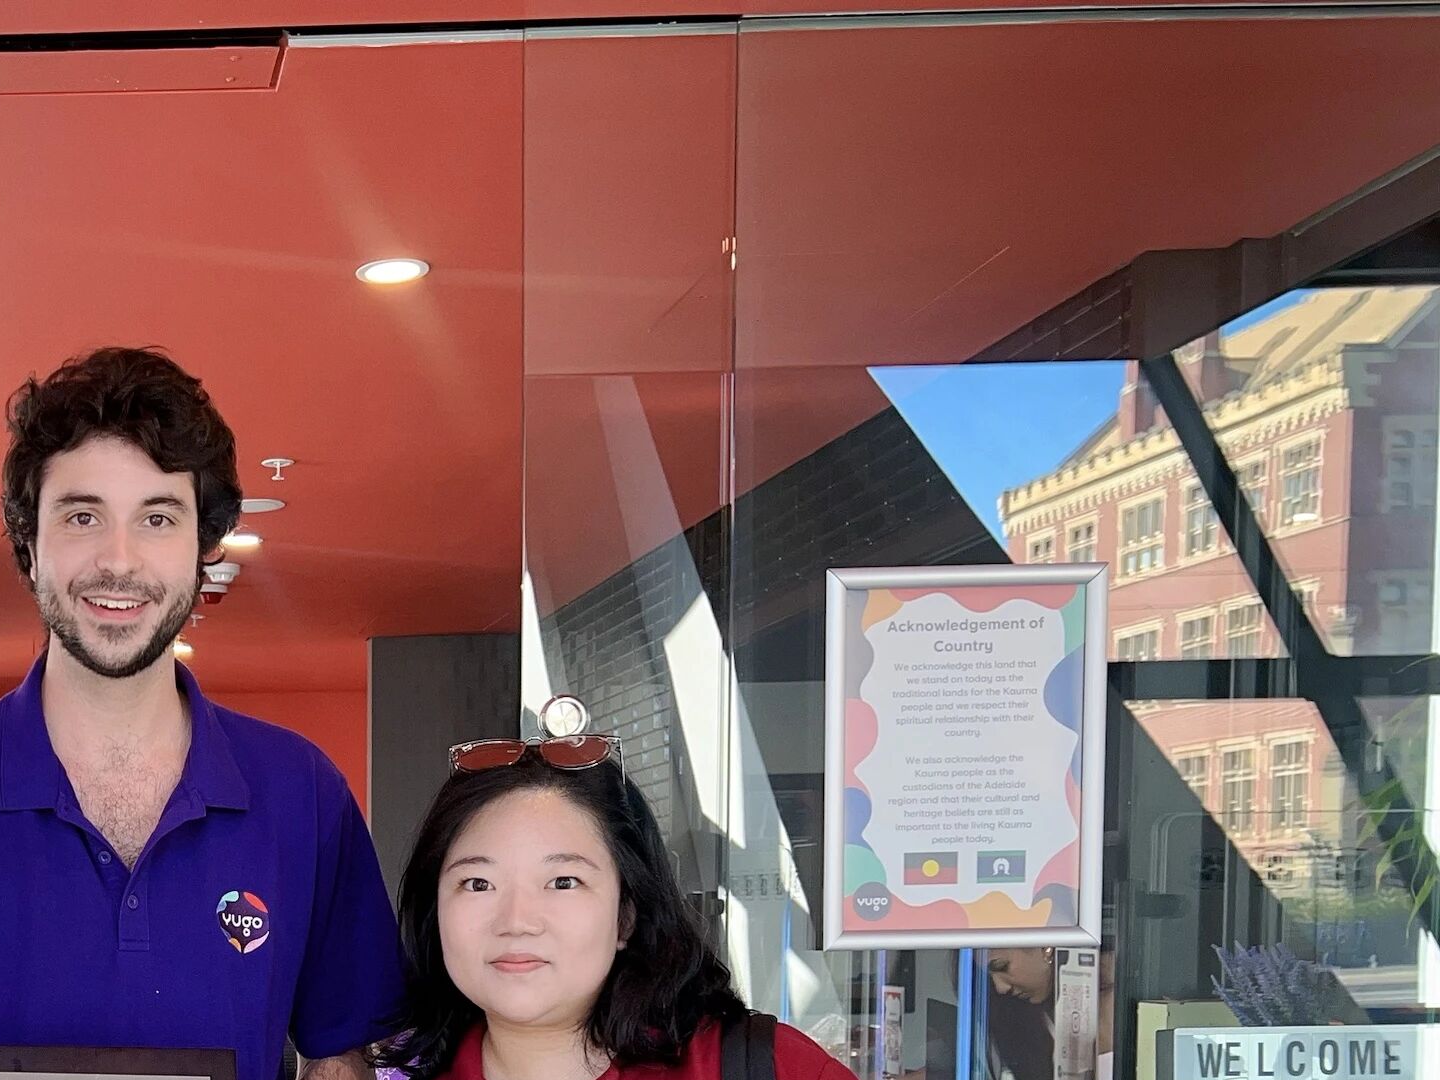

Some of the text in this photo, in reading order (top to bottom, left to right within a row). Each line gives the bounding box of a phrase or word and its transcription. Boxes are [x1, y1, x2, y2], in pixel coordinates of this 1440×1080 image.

[887, 617, 1045, 633] Acknowledgement of
[934, 640, 993, 653] Country
[912, 662, 973, 671] acknowledge
[976, 661, 992, 669] this
[1018, 660, 1036, 668] that
[922, 676, 948, 684] stand
[965, 675, 992, 683] today
[893, 690, 940, 698] traditional
[901, 703, 932, 712] people
[936, 702, 953, 710] and
[971, 702, 1006, 710] respect
[1008, 701, 1029, 709] their
[896, 716, 932, 726] spiritual
[935, 715, 989, 724] relationship
[992, 714, 1011, 722] with
[905, 754, 1023, 765] We also acknowledge the
[952, 768, 983, 778] people
[902, 783, 953, 791] custodians
[956, 782, 965, 790] of
[985, 781, 1026, 789] Adelaide
[888, 796, 917, 806] region
[920, 795, 938, 804] and
[941, 795, 959, 804] that
[962, 795, 982, 803] their
[985, 794, 1019, 802] cultural
[904, 810, 942, 819] heritage
[945, 809, 975, 817] beliefs
[895, 823, 940, 832] important
[954, 822, 968, 830] the
[971, 822, 995, 831] living
[932, 835, 995, 844] people today.
[222, 913, 262, 937] yugo
[1197, 1039, 1401, 1078] WELCOME
